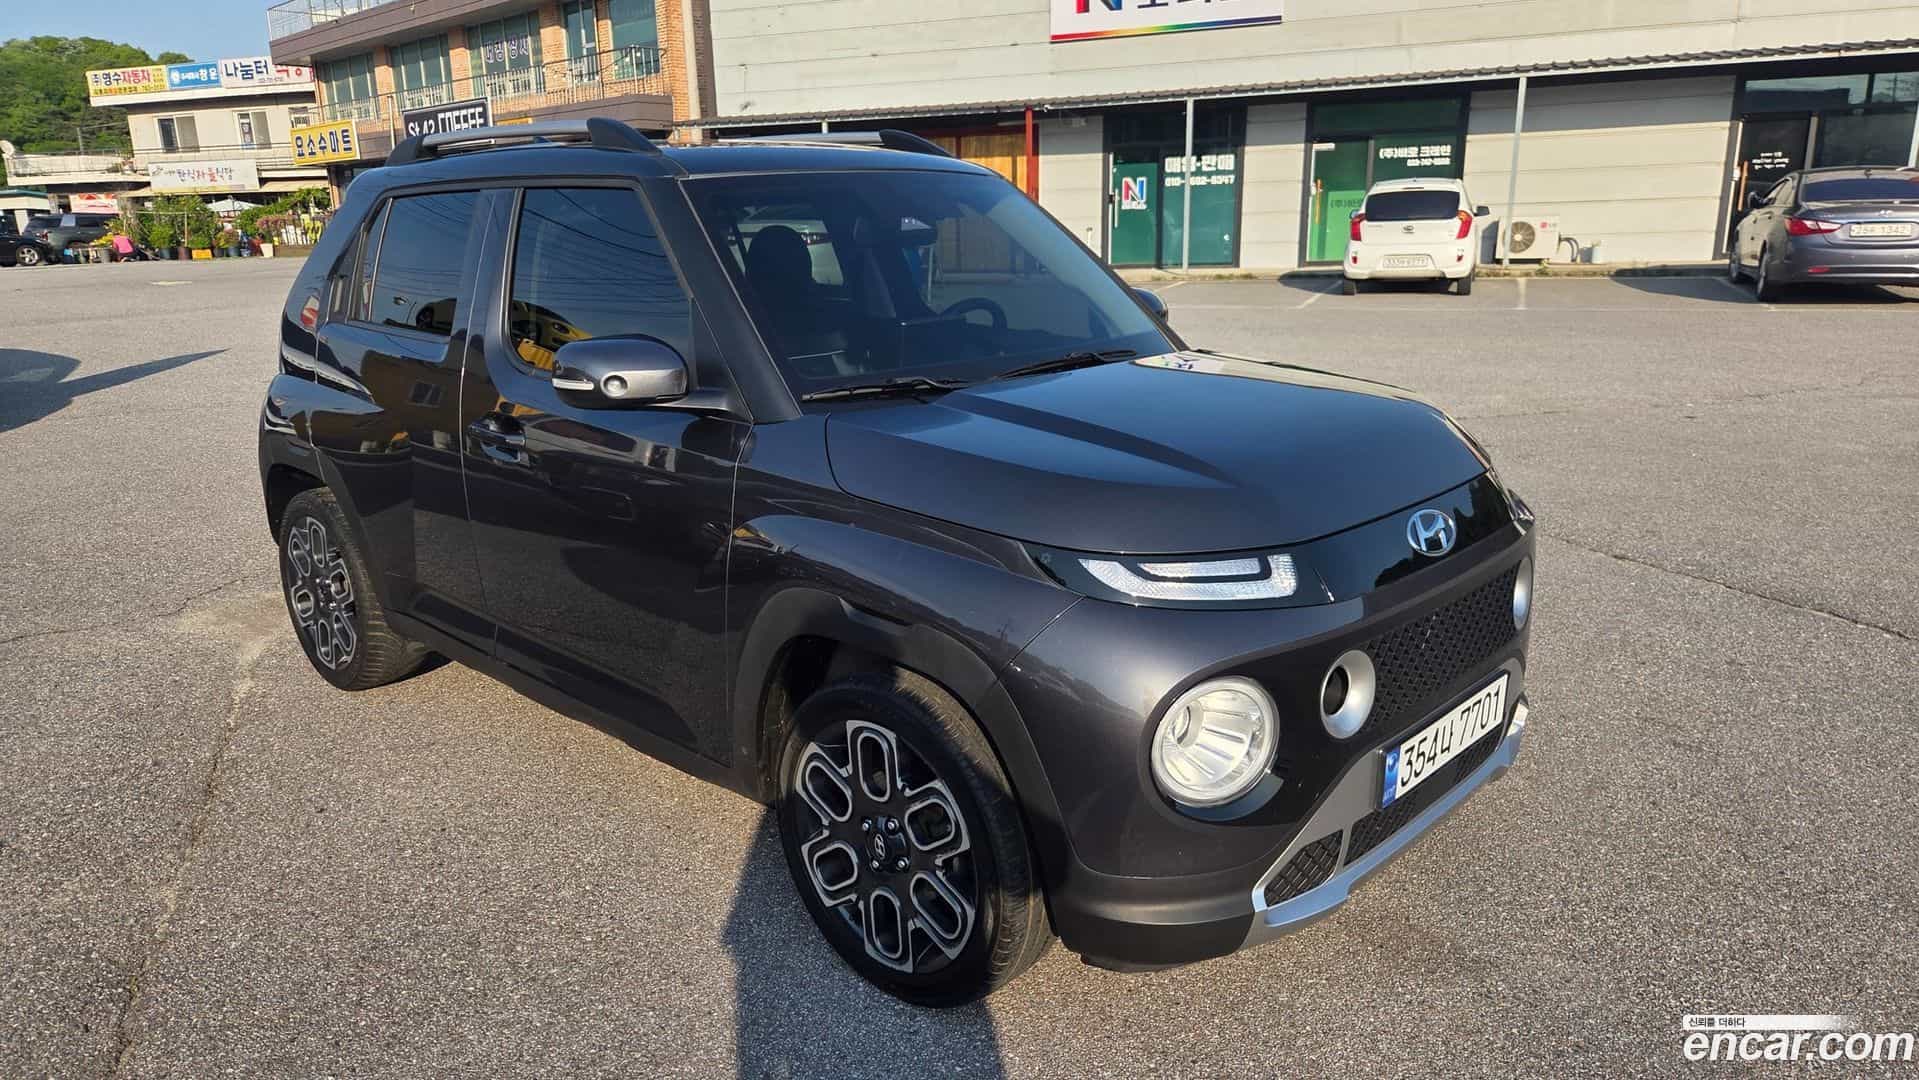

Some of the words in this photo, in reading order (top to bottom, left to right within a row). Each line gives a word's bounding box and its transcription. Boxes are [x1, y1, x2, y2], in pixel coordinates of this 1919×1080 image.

[224, 59, 269, 80] 나눔터
[295, 128, 353, 157] 요소수마트
[1459, 684, 1501, 746] 7701
